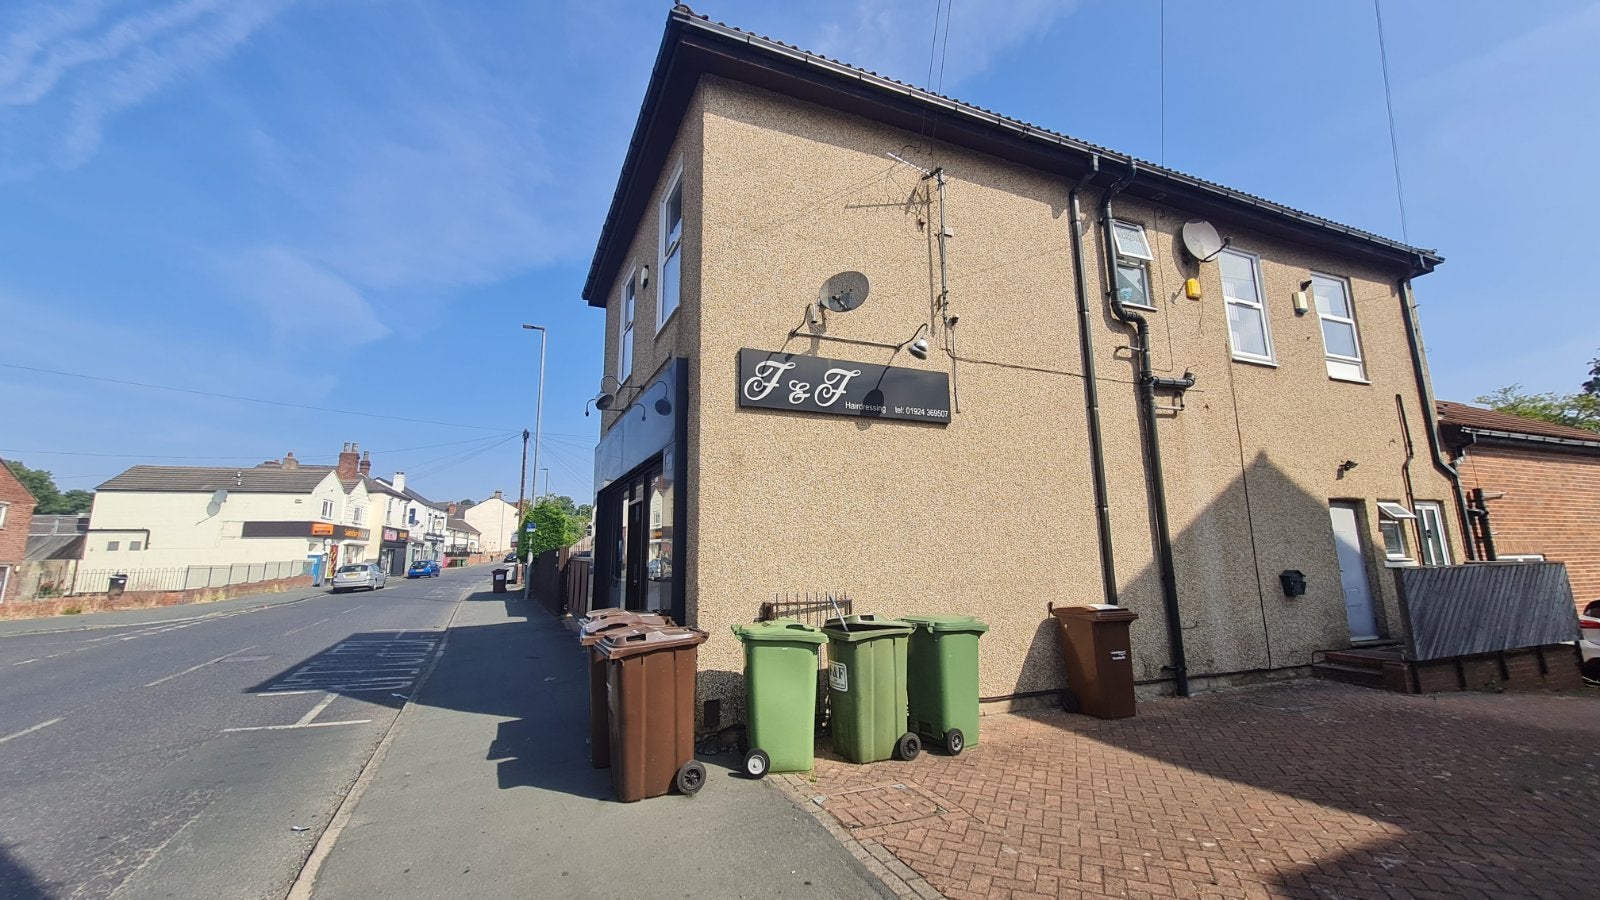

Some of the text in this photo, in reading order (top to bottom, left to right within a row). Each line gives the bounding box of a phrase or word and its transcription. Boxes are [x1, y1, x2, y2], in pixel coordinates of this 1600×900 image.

[744, 360, 861, 407] F & F
[845, 401, 948, 418] Hairdressing tel: 01924 369507
